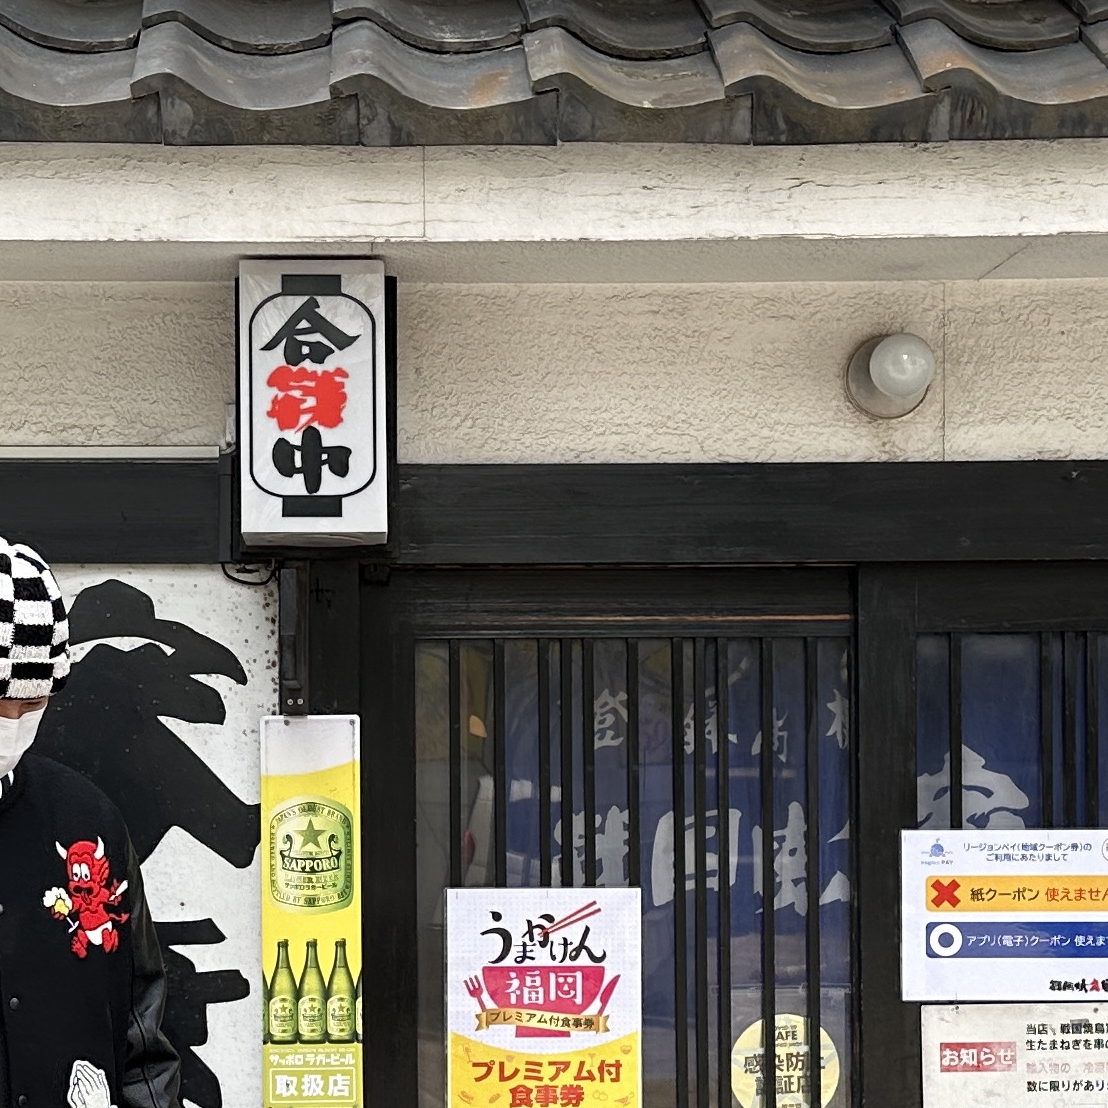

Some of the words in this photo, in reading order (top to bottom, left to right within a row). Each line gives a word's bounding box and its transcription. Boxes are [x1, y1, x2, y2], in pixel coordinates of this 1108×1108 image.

[283, 856, 339, 873] SAPPORO
[970, 887, 1040, 902] 紙クーポン
[489, 1010, 595, 1030] プレミアム付食事券
[775, 1030, 798, 1041] AFE
[1025, 1038, 1108, 1051] 生たまねぎを串
[941, 1047, 1015, 1067] お知らせ
[472, 1059, 623, 1083] プレミアム付
[274, 1073, 351, 1097] 取扱店
[1026, 1079, 1108, 1093] 数に限りがあり
[509, 1083, 584, 1108] 食事券
